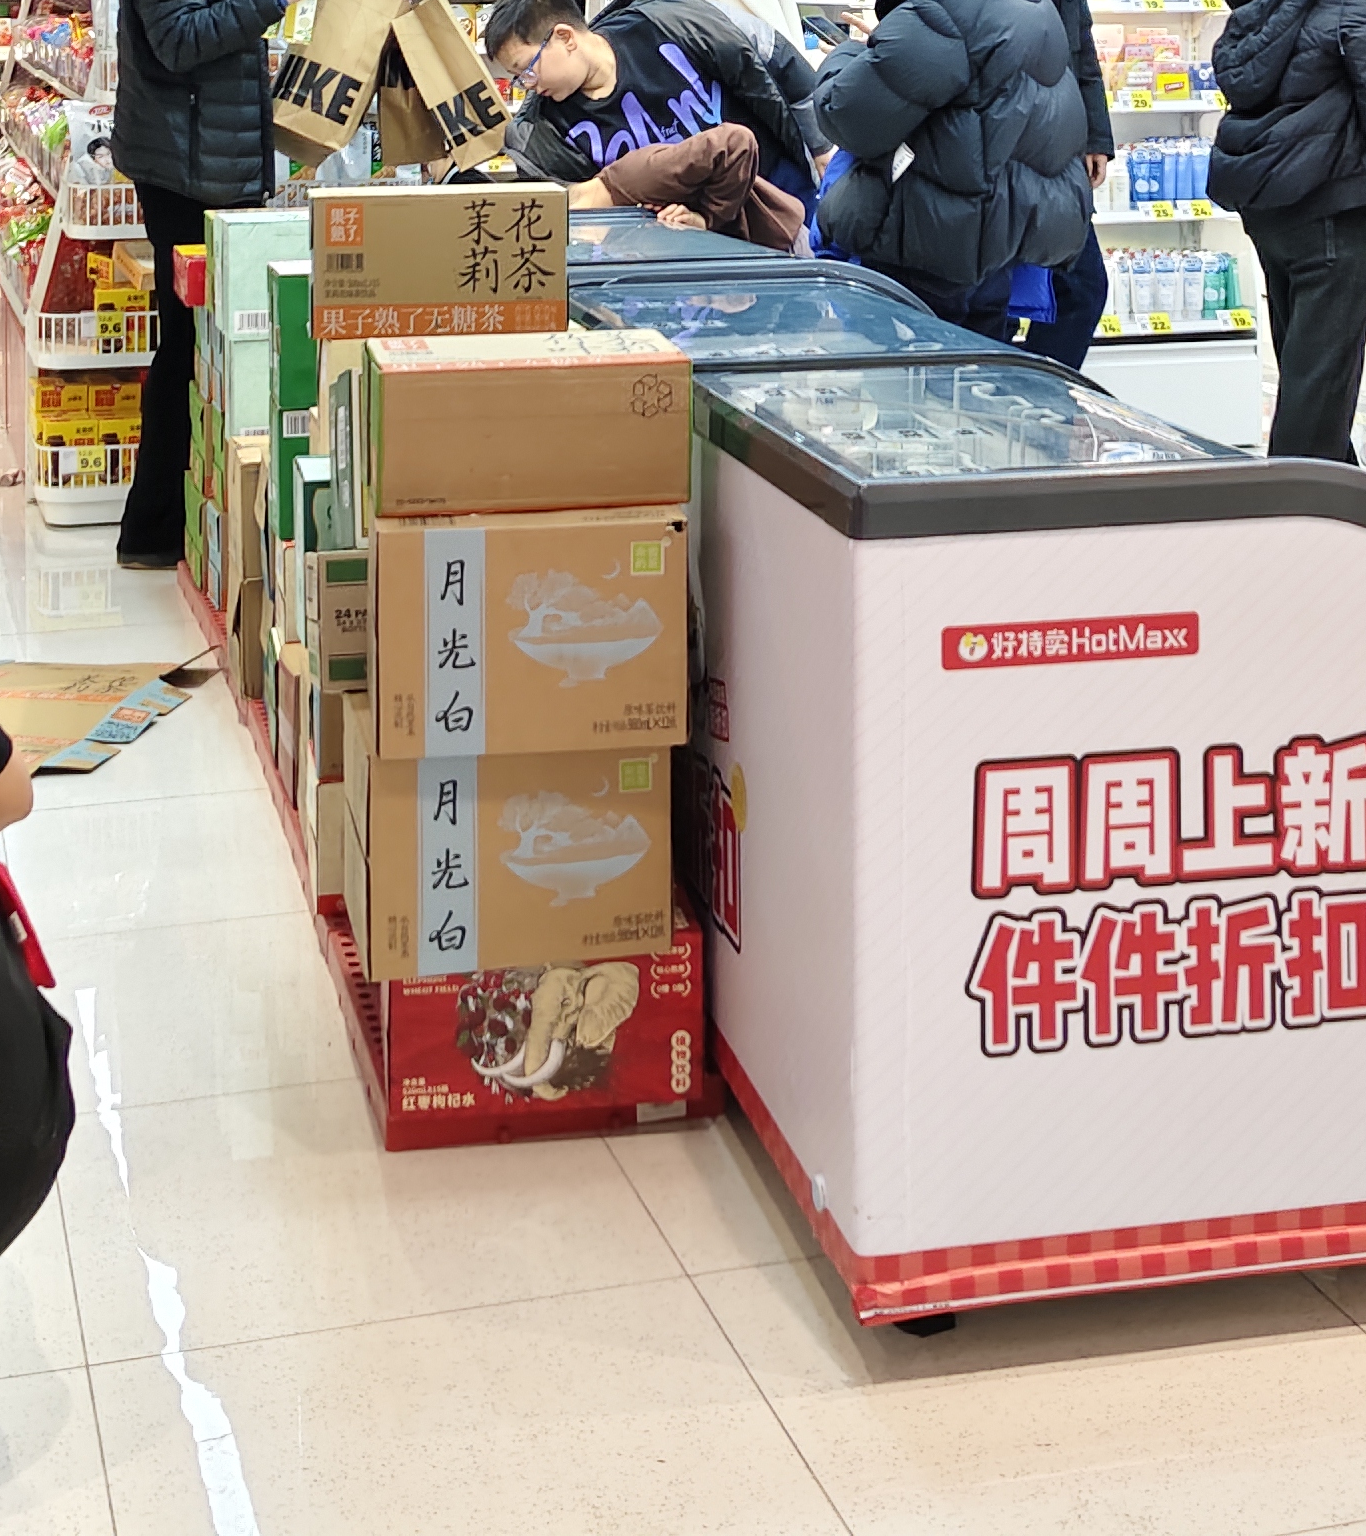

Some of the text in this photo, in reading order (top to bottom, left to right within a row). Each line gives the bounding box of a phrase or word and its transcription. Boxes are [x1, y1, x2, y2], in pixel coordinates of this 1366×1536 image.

[436, 80, 508, 149] KE
[329, 207, 360, 225] 果子
[330, 225, 358, 242] 熟了
[100, 322, 123, 335] 9.6
[320, 303, 505, 336] 果子熟了无糖茶
[80, 457, 103, 470] 9.6
[435, 559, 477, 733] 月光白
[428, 777, 470, 951] 月光白
[402, 1093, 475, 1112] 红枣枸杞水
